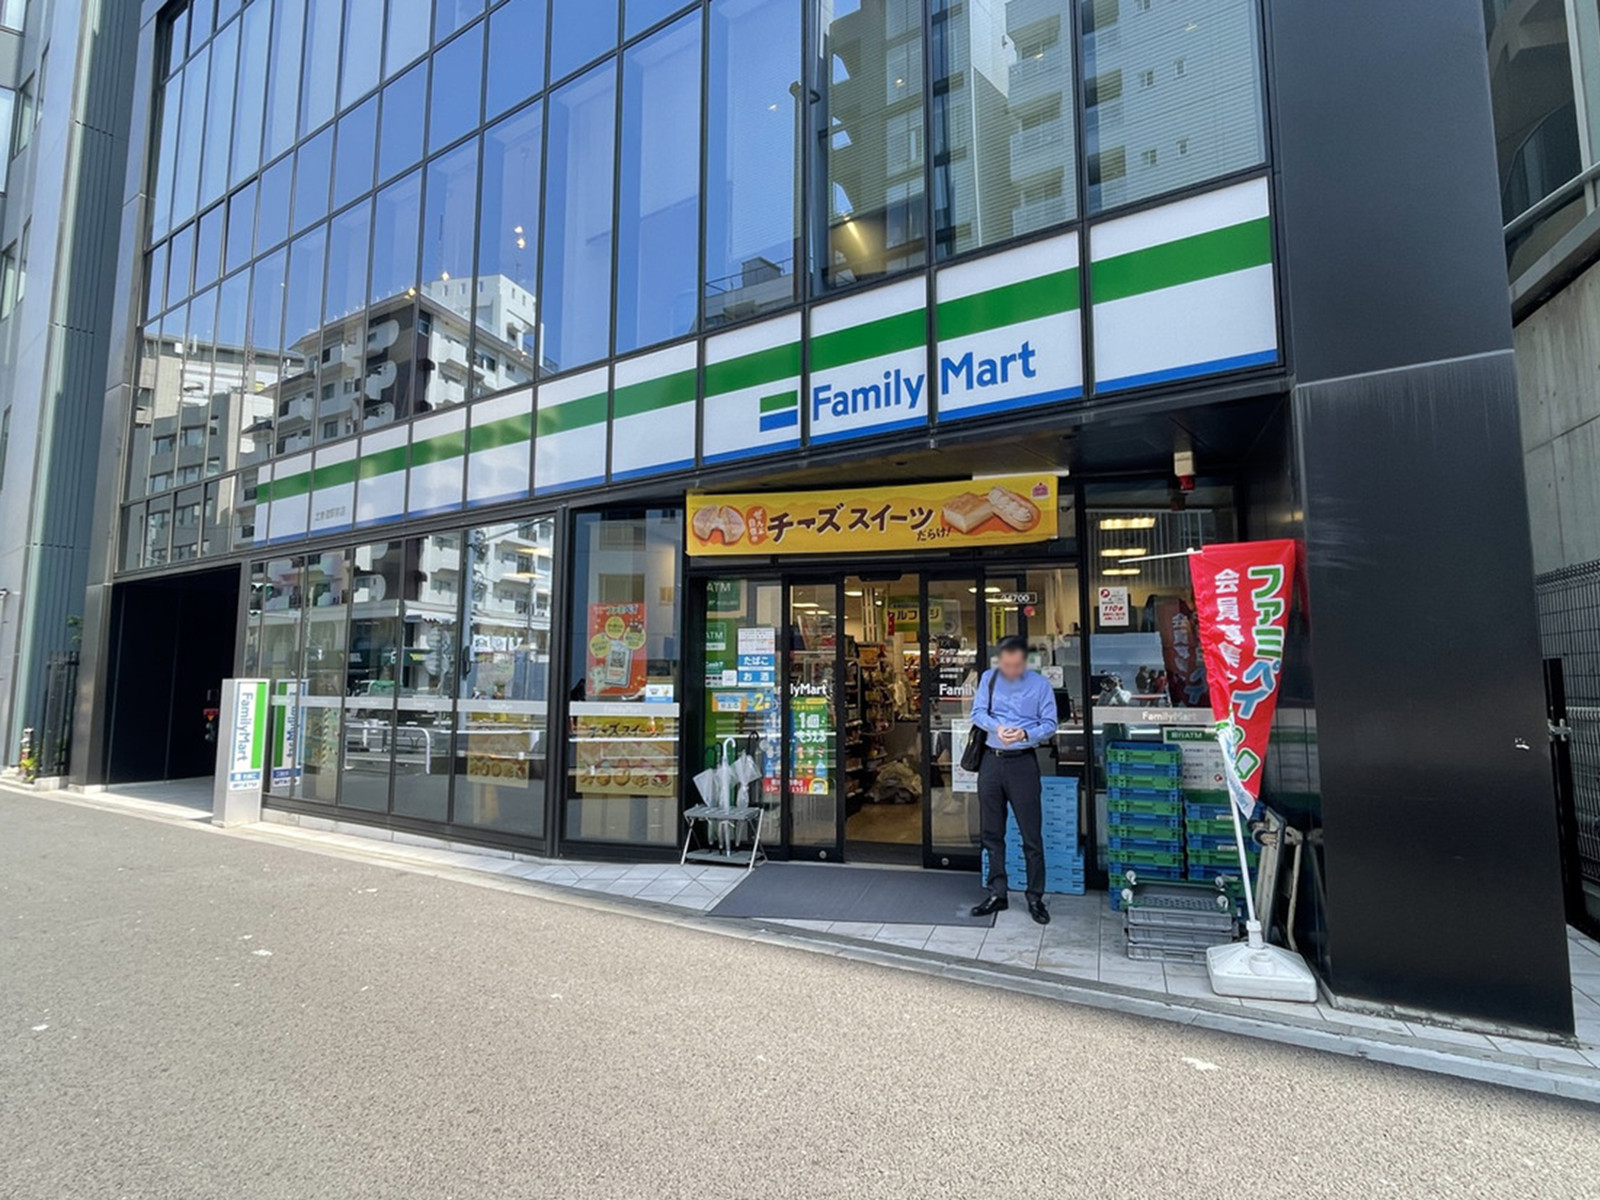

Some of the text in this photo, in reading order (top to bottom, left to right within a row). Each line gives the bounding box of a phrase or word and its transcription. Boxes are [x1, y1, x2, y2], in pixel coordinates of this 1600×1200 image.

[812, 341, 1036, 421] Family Mart
[767, 502, 934, 543] チーズスイーツ
[706, 582, 731, 592] ATM
[743, 655, 769, 666] たばこ
[1230, 563, 1285, 720] ファミペイ
[234, 691, 254, 763] FamilyMart
[1141, 711, 1198, 723] FamilyMart
